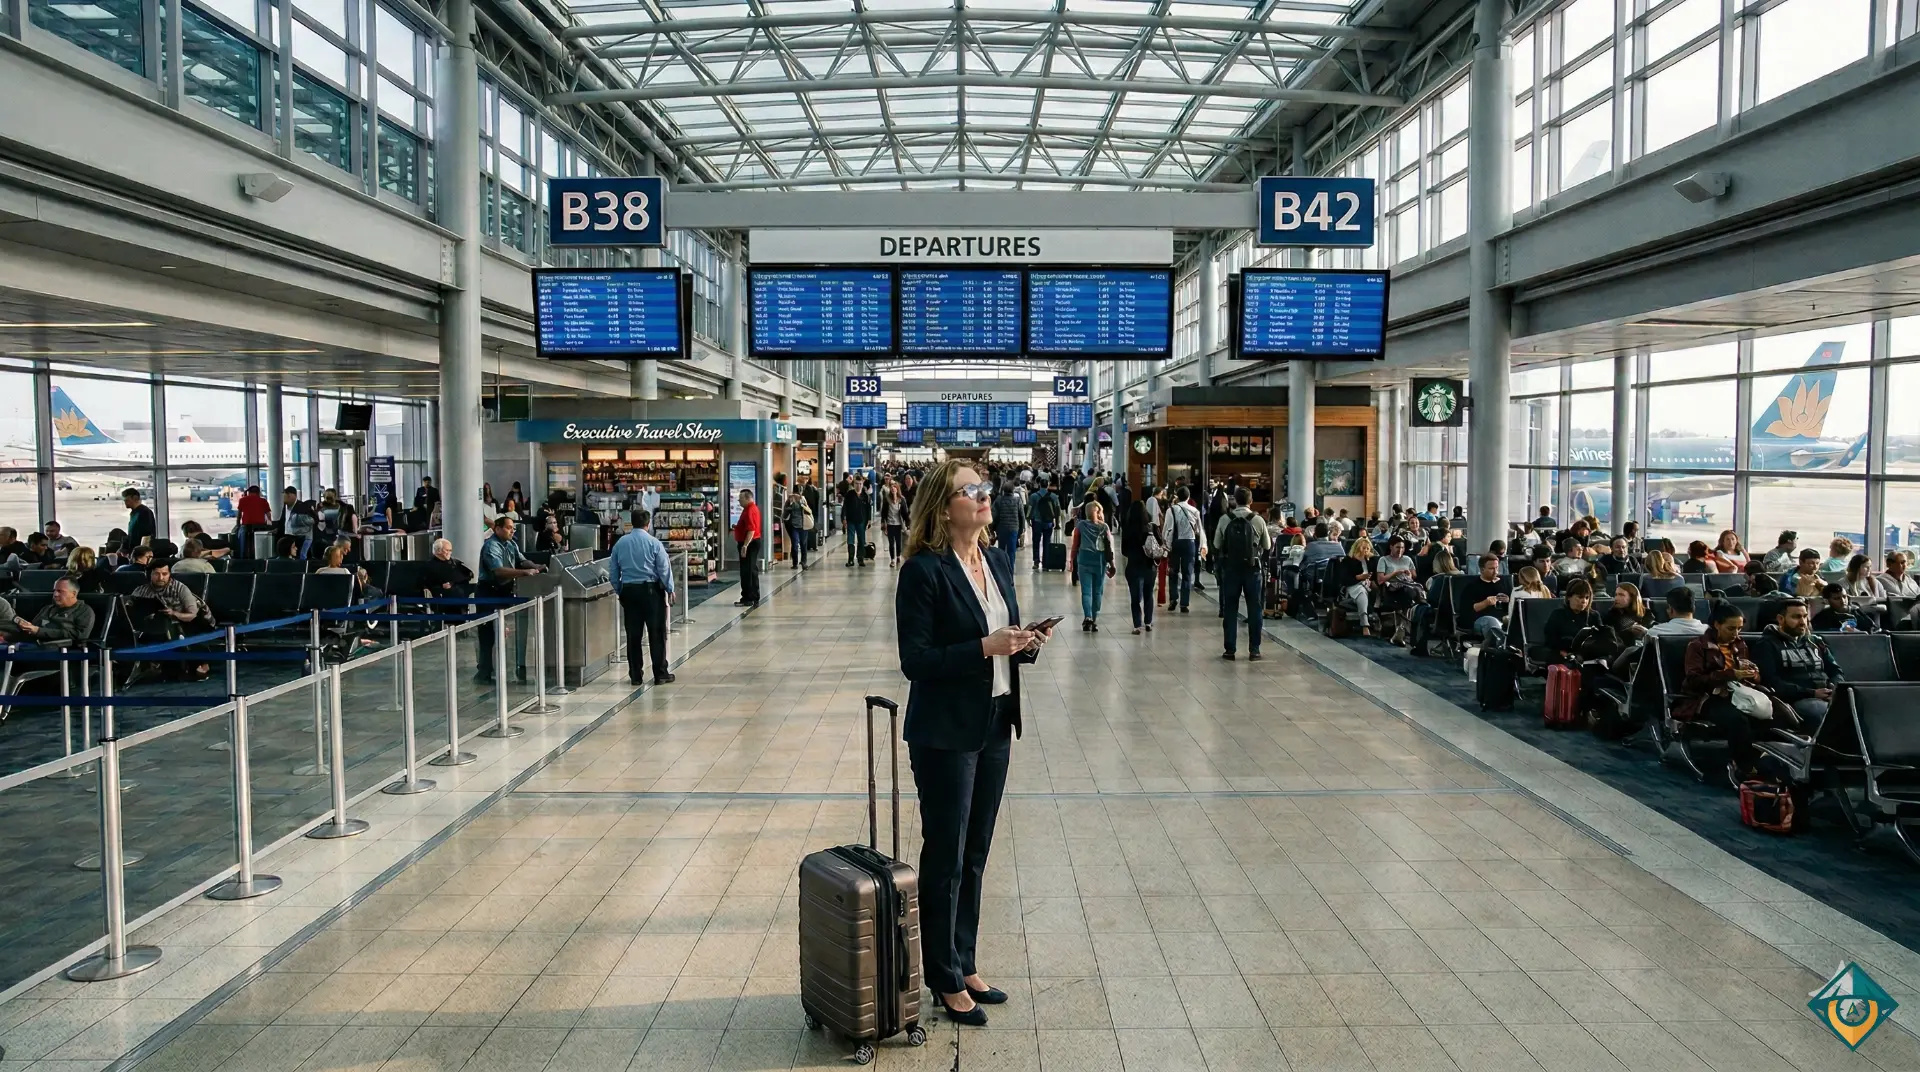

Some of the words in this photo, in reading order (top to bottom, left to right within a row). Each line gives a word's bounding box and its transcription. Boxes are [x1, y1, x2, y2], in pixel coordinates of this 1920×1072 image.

[562, 191, 650, 231] B38
[1274, 191, 1361, 231] B42
[880, 236, 1041, 257] DEPARTURES
[850, 379, 878, 393] B38
[1057, 379, 1084, 393] B42
[941, 392, 993, 401] DEPARTURES
[563, 423, 634, 440] Executive
[635, 423, 683, 440] Travel
[682, 423, 723, 443] Shop
